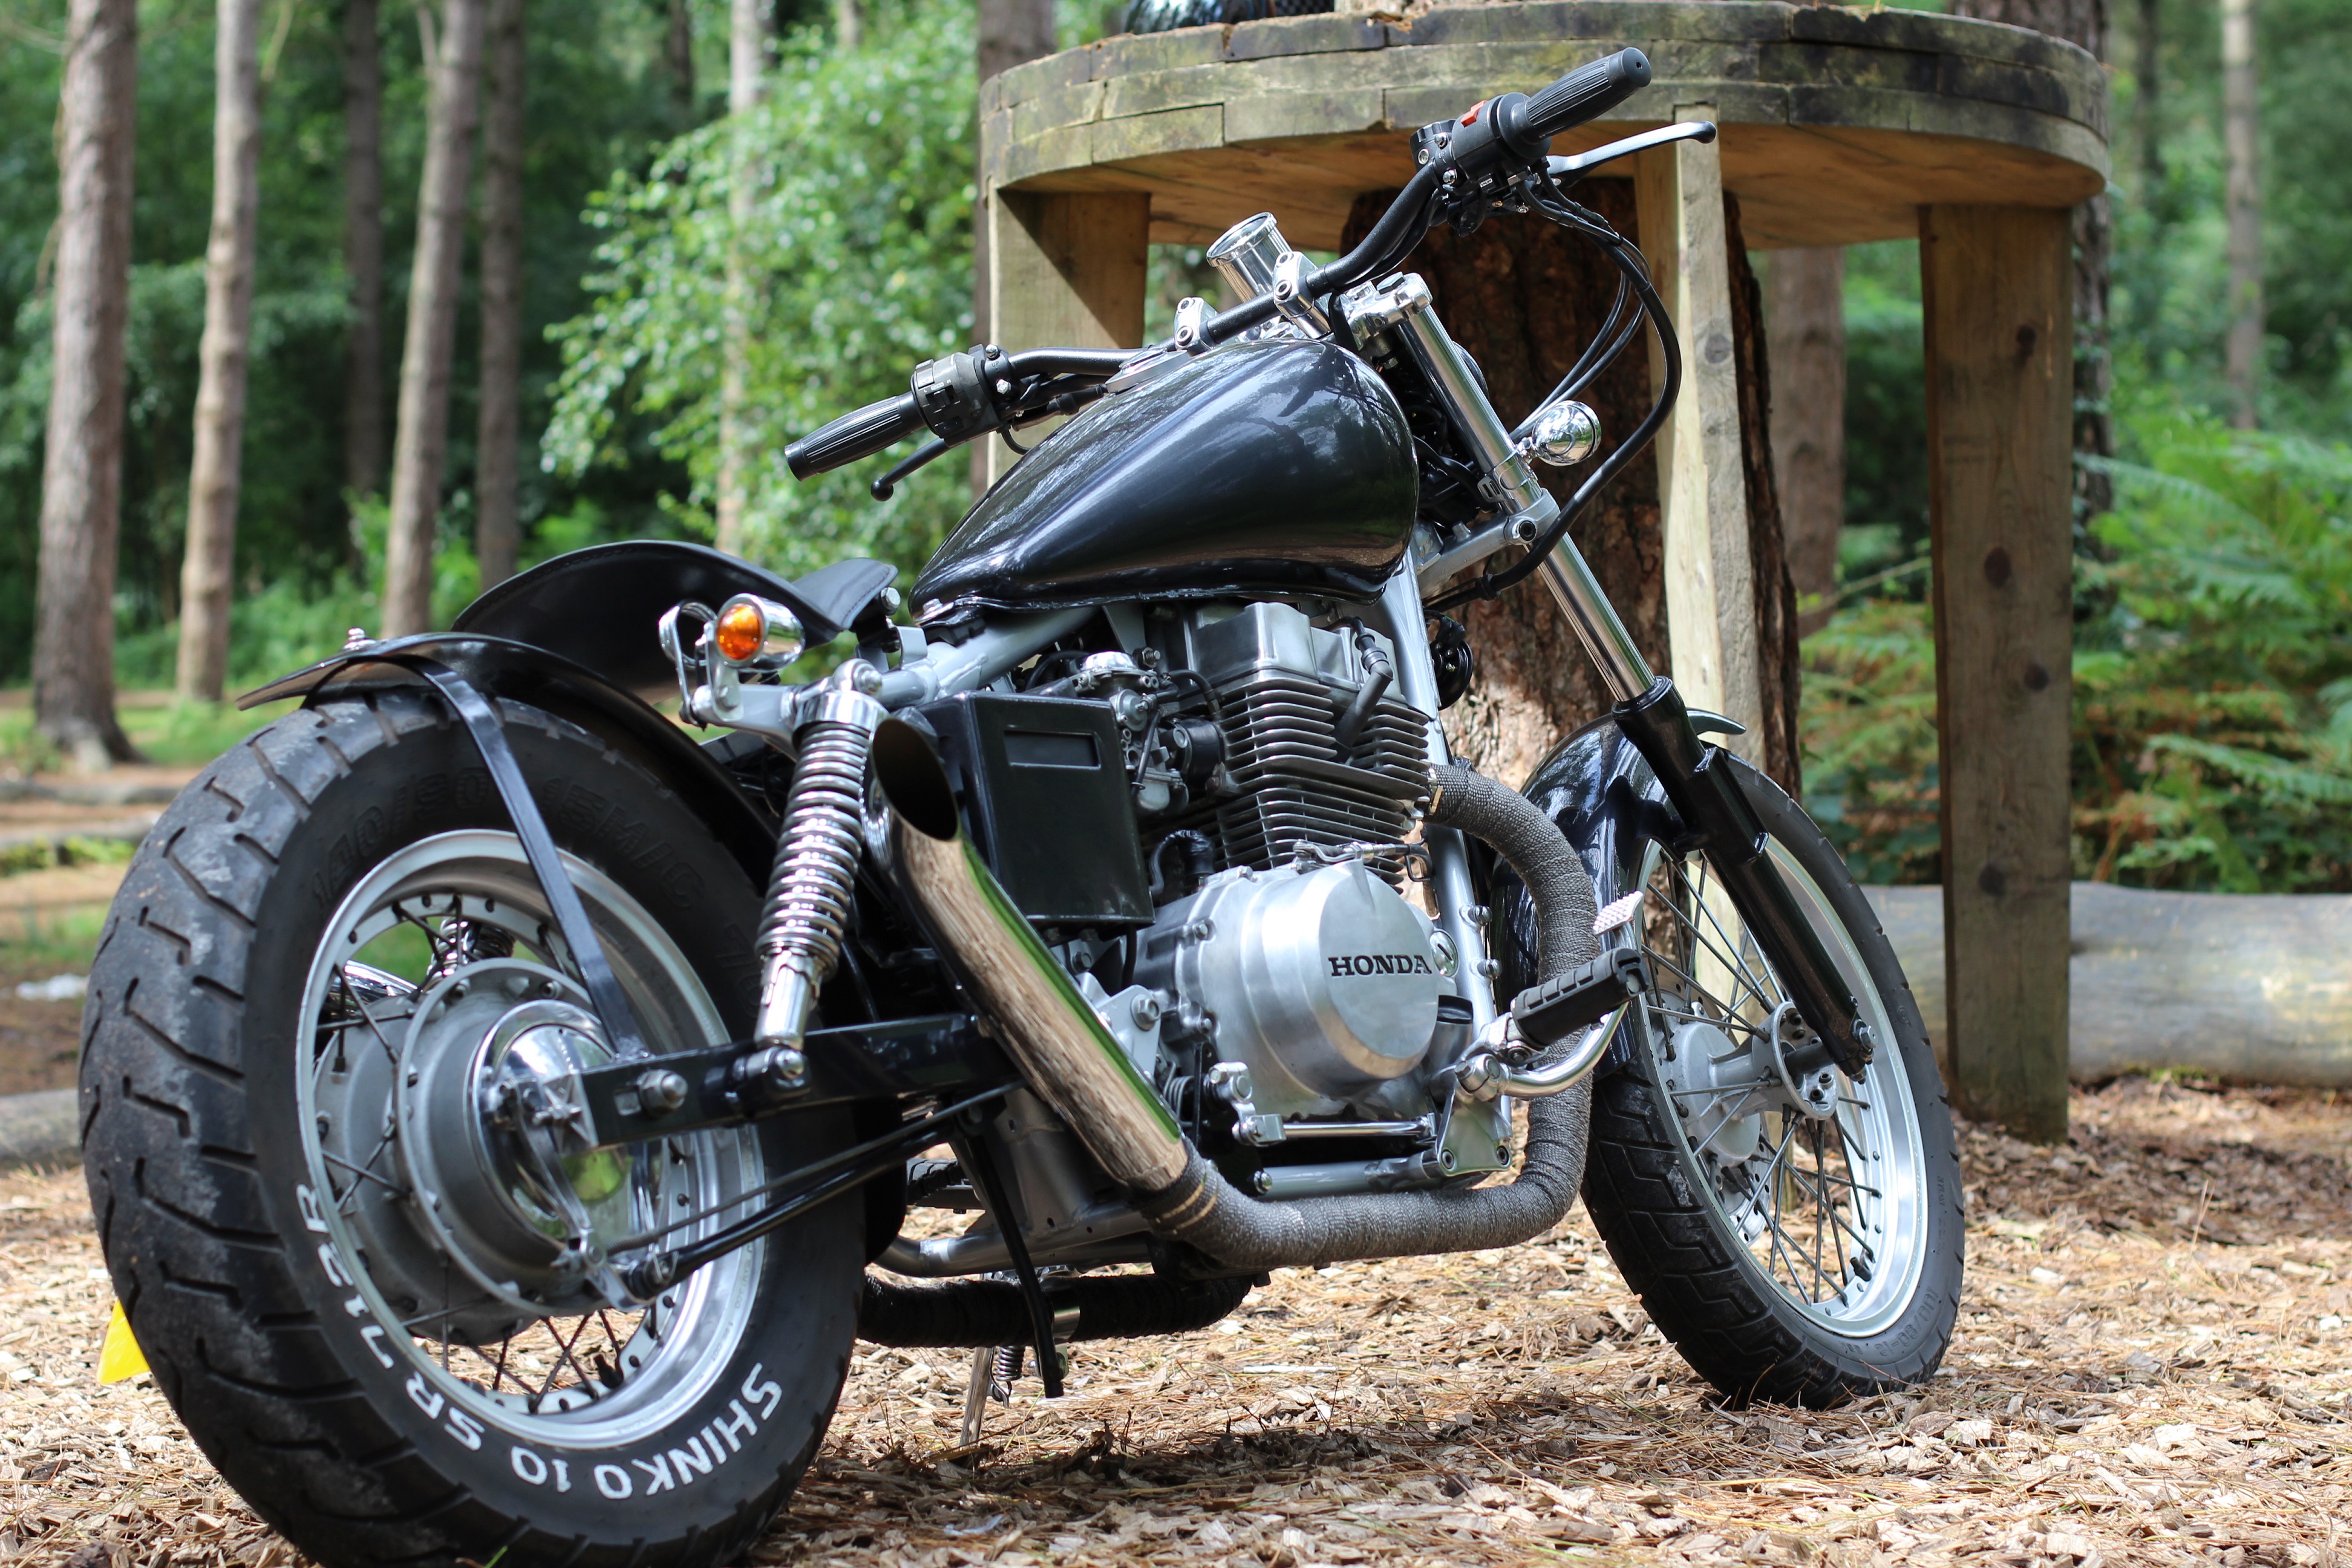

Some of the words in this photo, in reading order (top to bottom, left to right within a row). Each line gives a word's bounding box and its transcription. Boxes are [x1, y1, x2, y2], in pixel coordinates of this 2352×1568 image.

[1328, 955, 1432, 977] HONDA
[593, 1362, 783, 1500] SHINKO
[511, 1446, 572, 1493] 10
